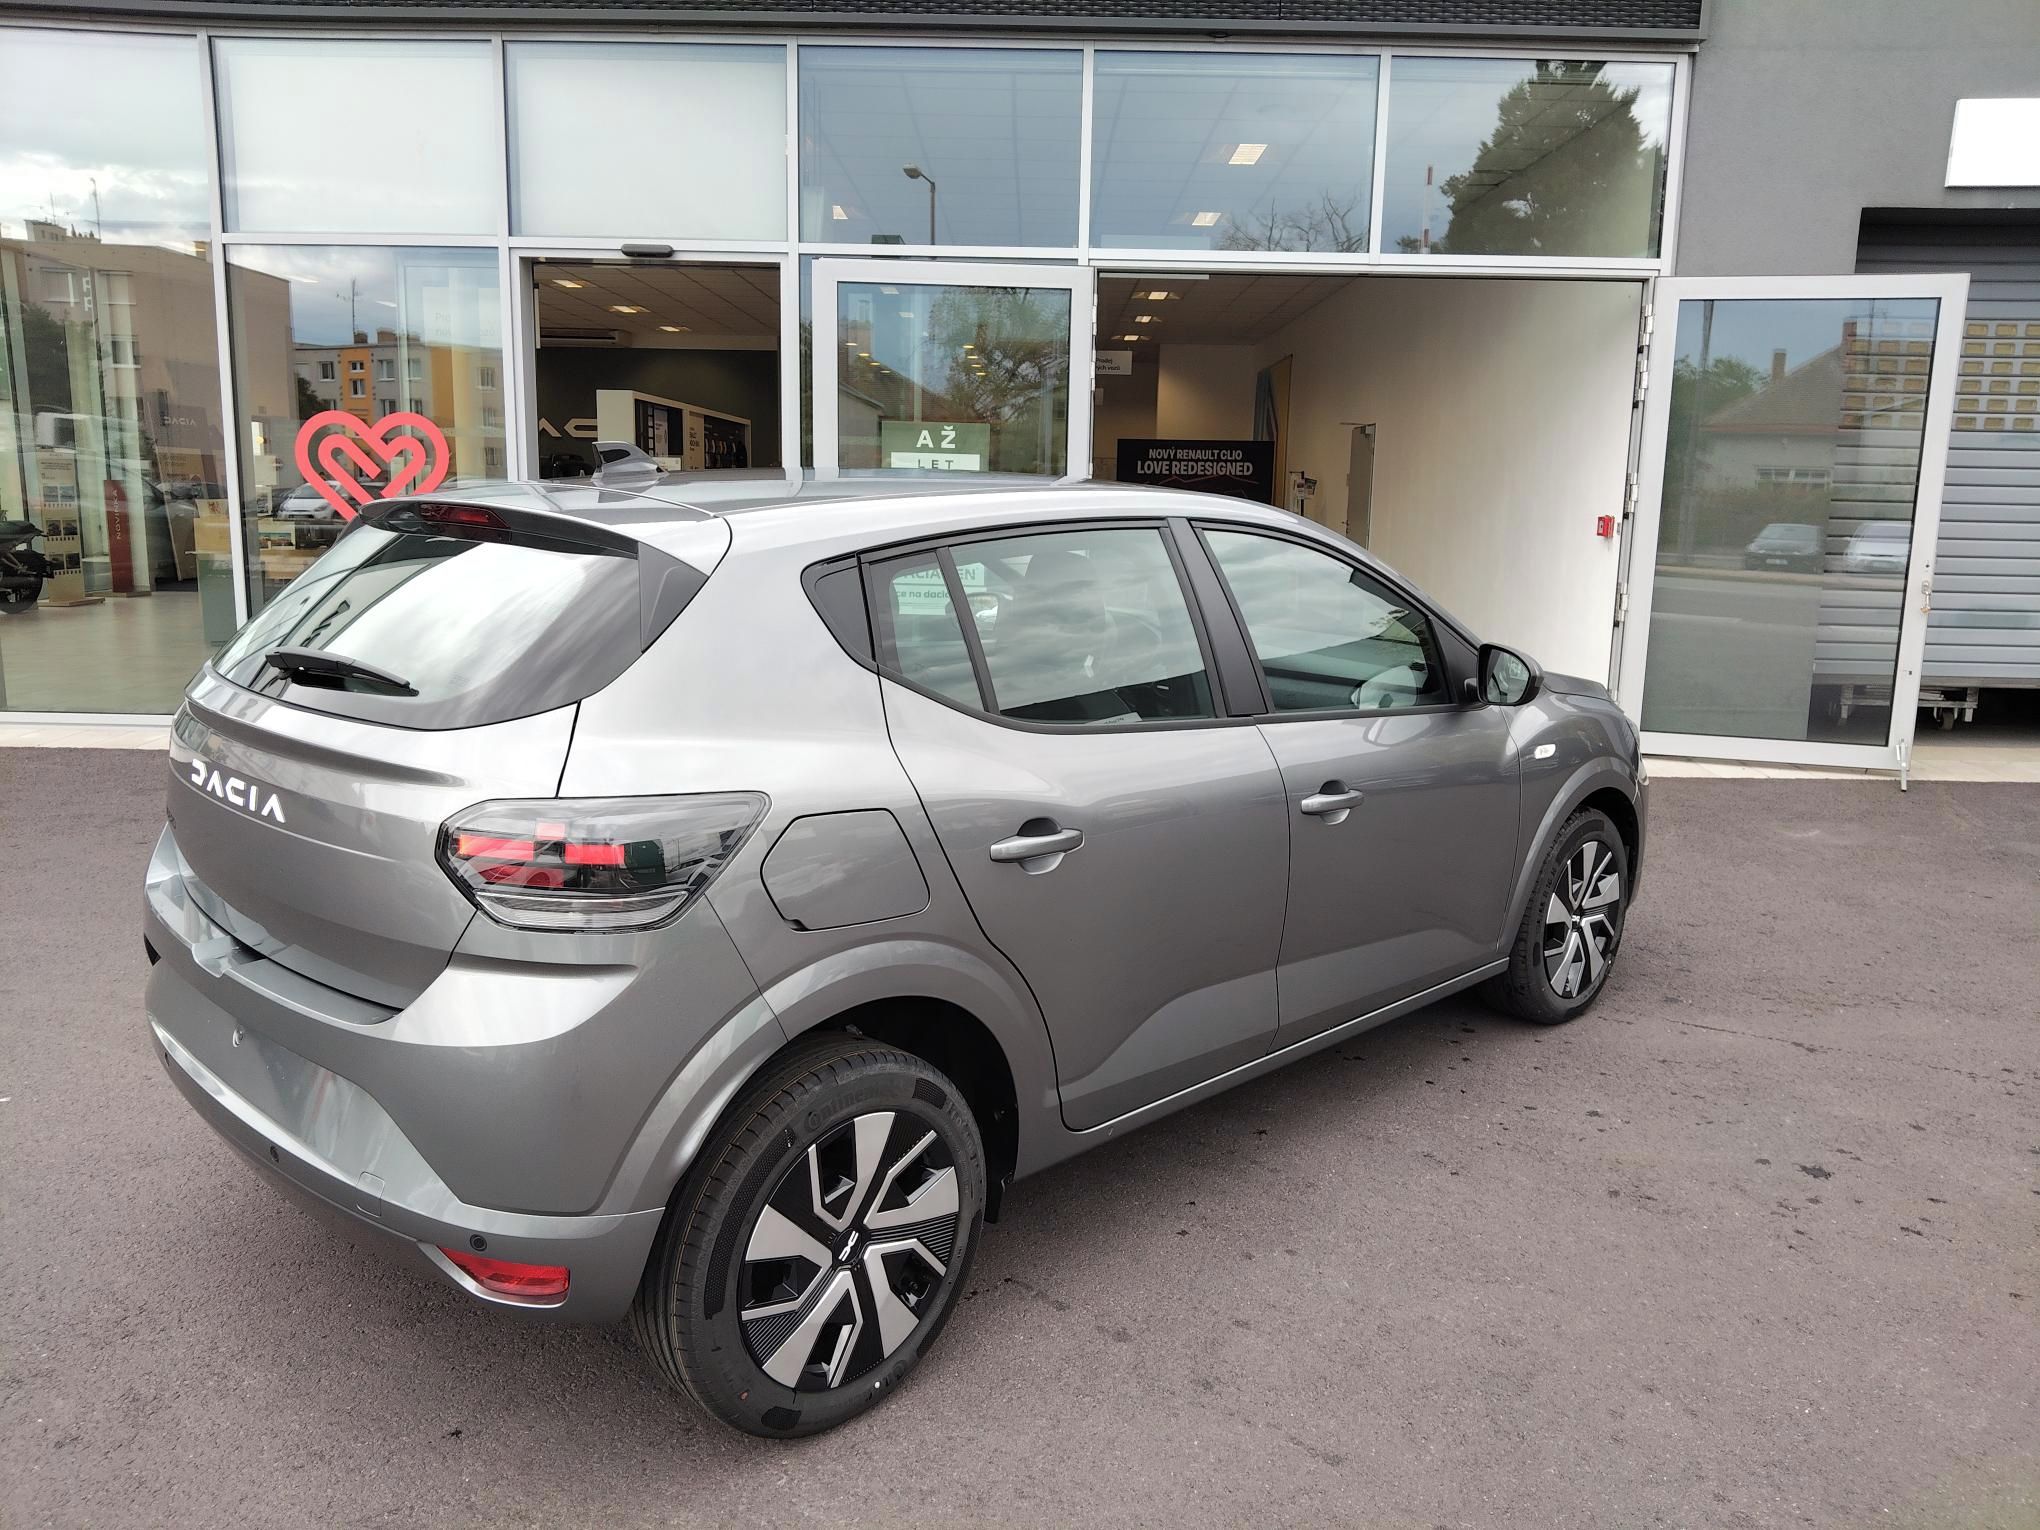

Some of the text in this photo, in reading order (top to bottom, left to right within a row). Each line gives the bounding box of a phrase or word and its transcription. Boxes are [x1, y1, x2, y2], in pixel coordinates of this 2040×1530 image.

[916, 425, 956, 449] AŽ
[1148, 446, 1243, 461] NOVÝ RENAULT CLIO
[1137, 460, 1253, 476] LOVE REDESIGNED
[112, 489, 122, 541] NOVINKA
[191, 758, 285, 823] DACIA
